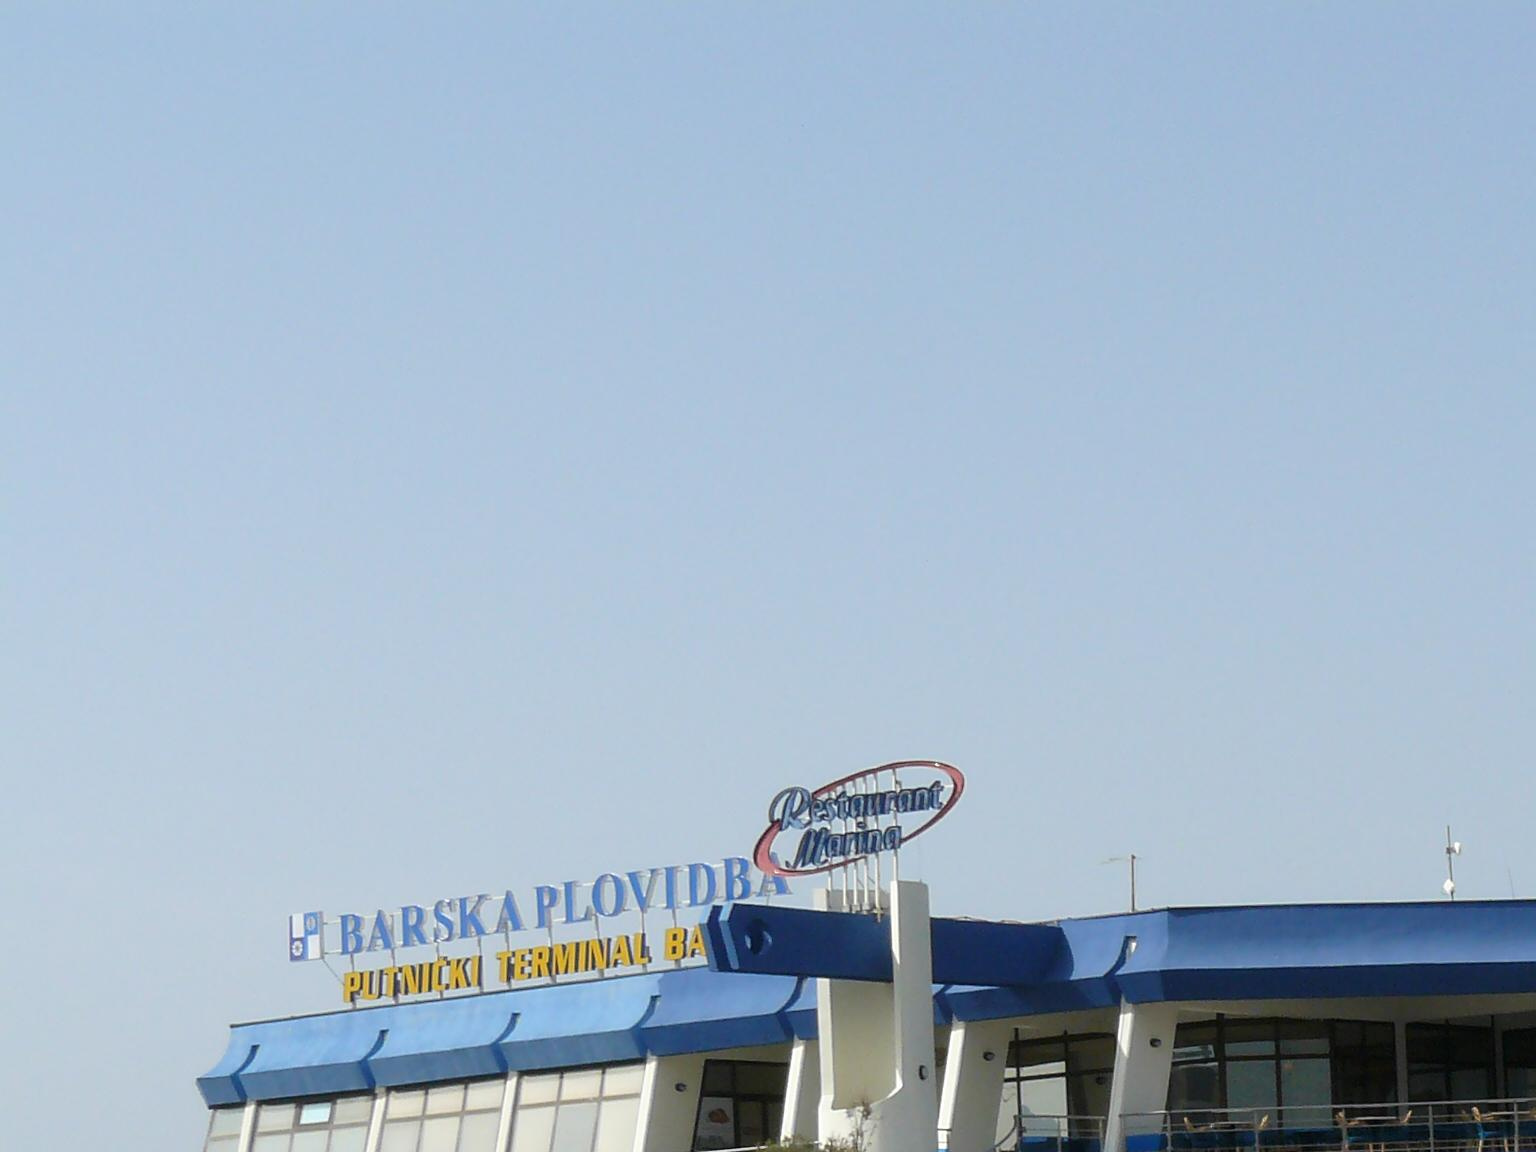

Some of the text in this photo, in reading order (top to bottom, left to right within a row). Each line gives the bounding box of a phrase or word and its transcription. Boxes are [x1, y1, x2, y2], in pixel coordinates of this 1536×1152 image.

[769, 780, 945, 831] Restaurant
[786, 821, 902, 869] Marina
[337, 852, 792, 956] BARSKA PLOVIDBA
[343, 954, 484, 1003] PUTNIČKI
[496, 931, 651, 984] TERMINAL
